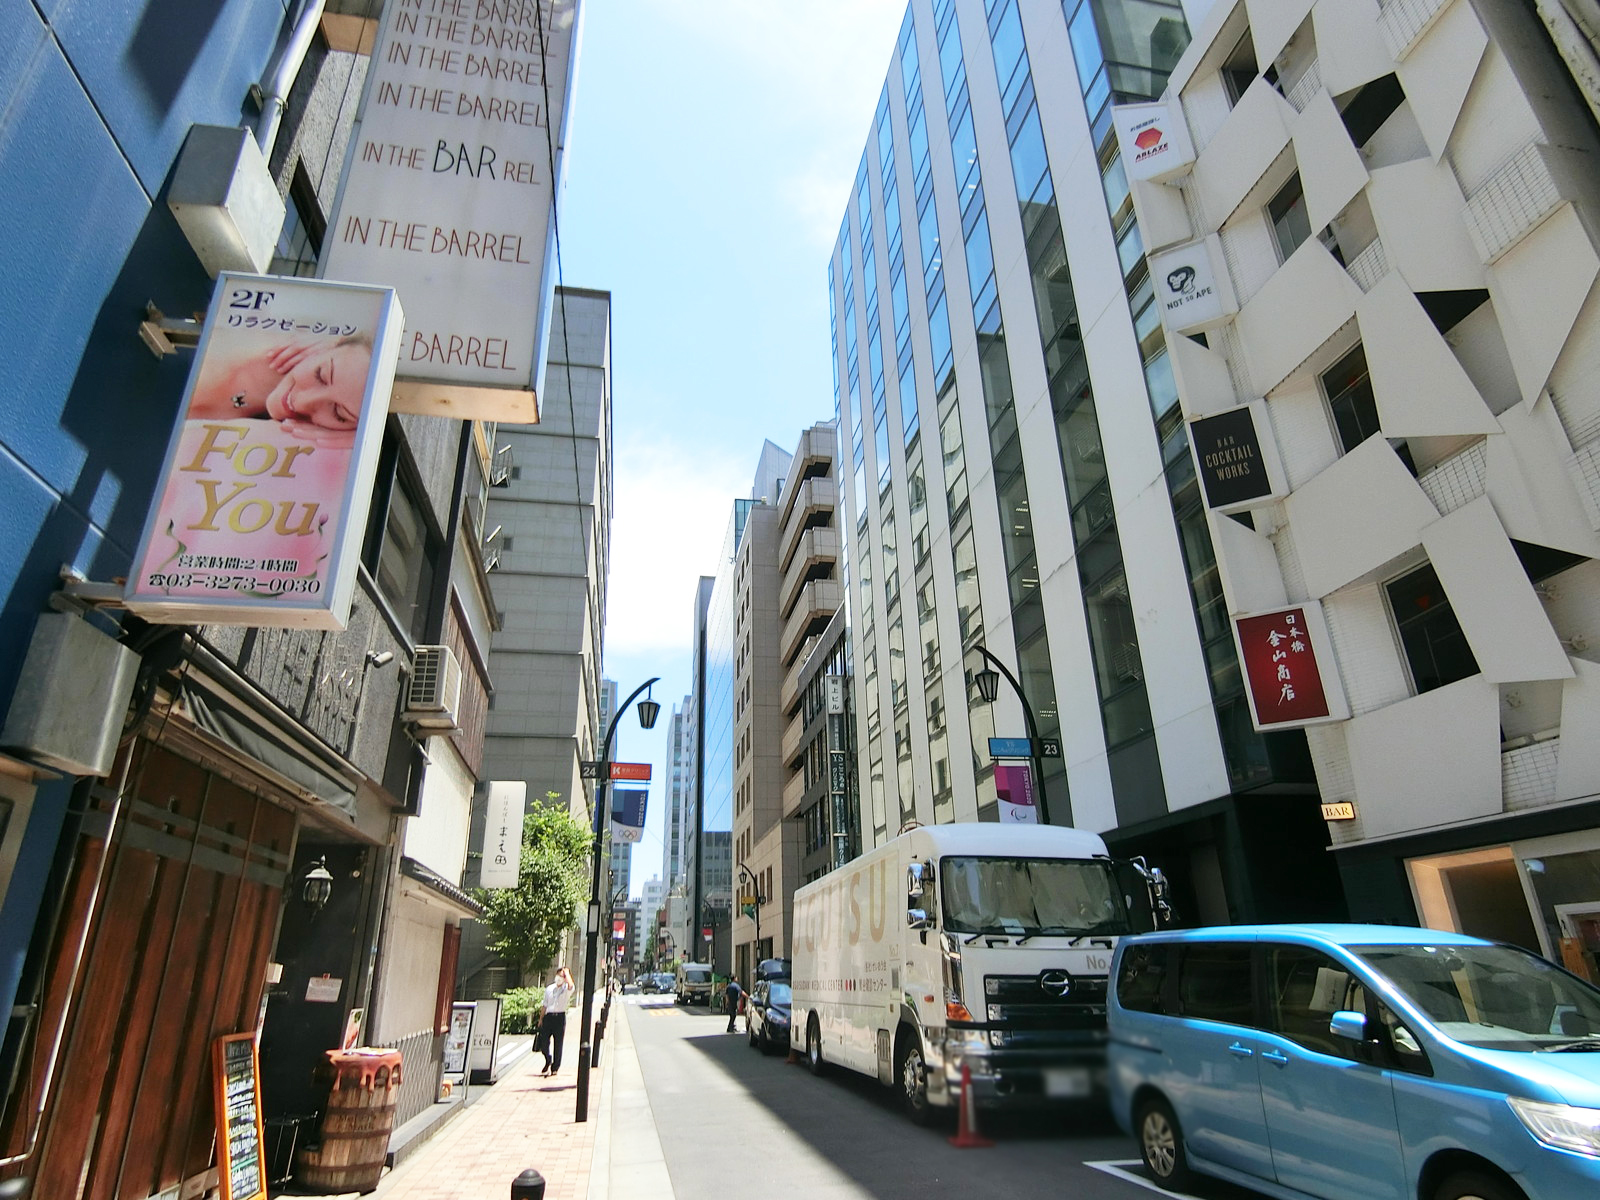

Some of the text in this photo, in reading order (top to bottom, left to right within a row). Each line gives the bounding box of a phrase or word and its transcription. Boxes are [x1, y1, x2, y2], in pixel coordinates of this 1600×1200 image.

[396, 12, 557, 57] IN THE BARREL
[388, 42, 553, 88] IN THE BARREL
[378, 81, 548, 128] IN THE BARREL
[362, 141, 382, 164] IN
[388, 144, 427, 171] THE
[1135, 142, 1168, 161] ABLAZE
[344, 216, 530, 264] IN THE BARREL
[229, 289, 275, 311] 2F
[1167, 298, 1183, 310] NOT
[1196, 286, 1212, 299] APE
[228, 314, 358, 336] リラクゼーション
[410, 331, 517, 371] BARREL
[180, 424, 314, 478] For
[1216, 435, 1235, 449] BAR
[1205, 444, 1254, 468] COCKTAIL
[1216, 462, 1250, 481] WORKS
[186, 480, 320, 537] You
[1285, 614, 1305, 653] 日本橋
[1266, 630, 1295, 706] 金山商店
[1044, 744, 1058, 755] 23
[583, 766, 596, 777] 24
[1325, 806, 1350, 816] BAR
[828, 979, 843, 992] CENTER
